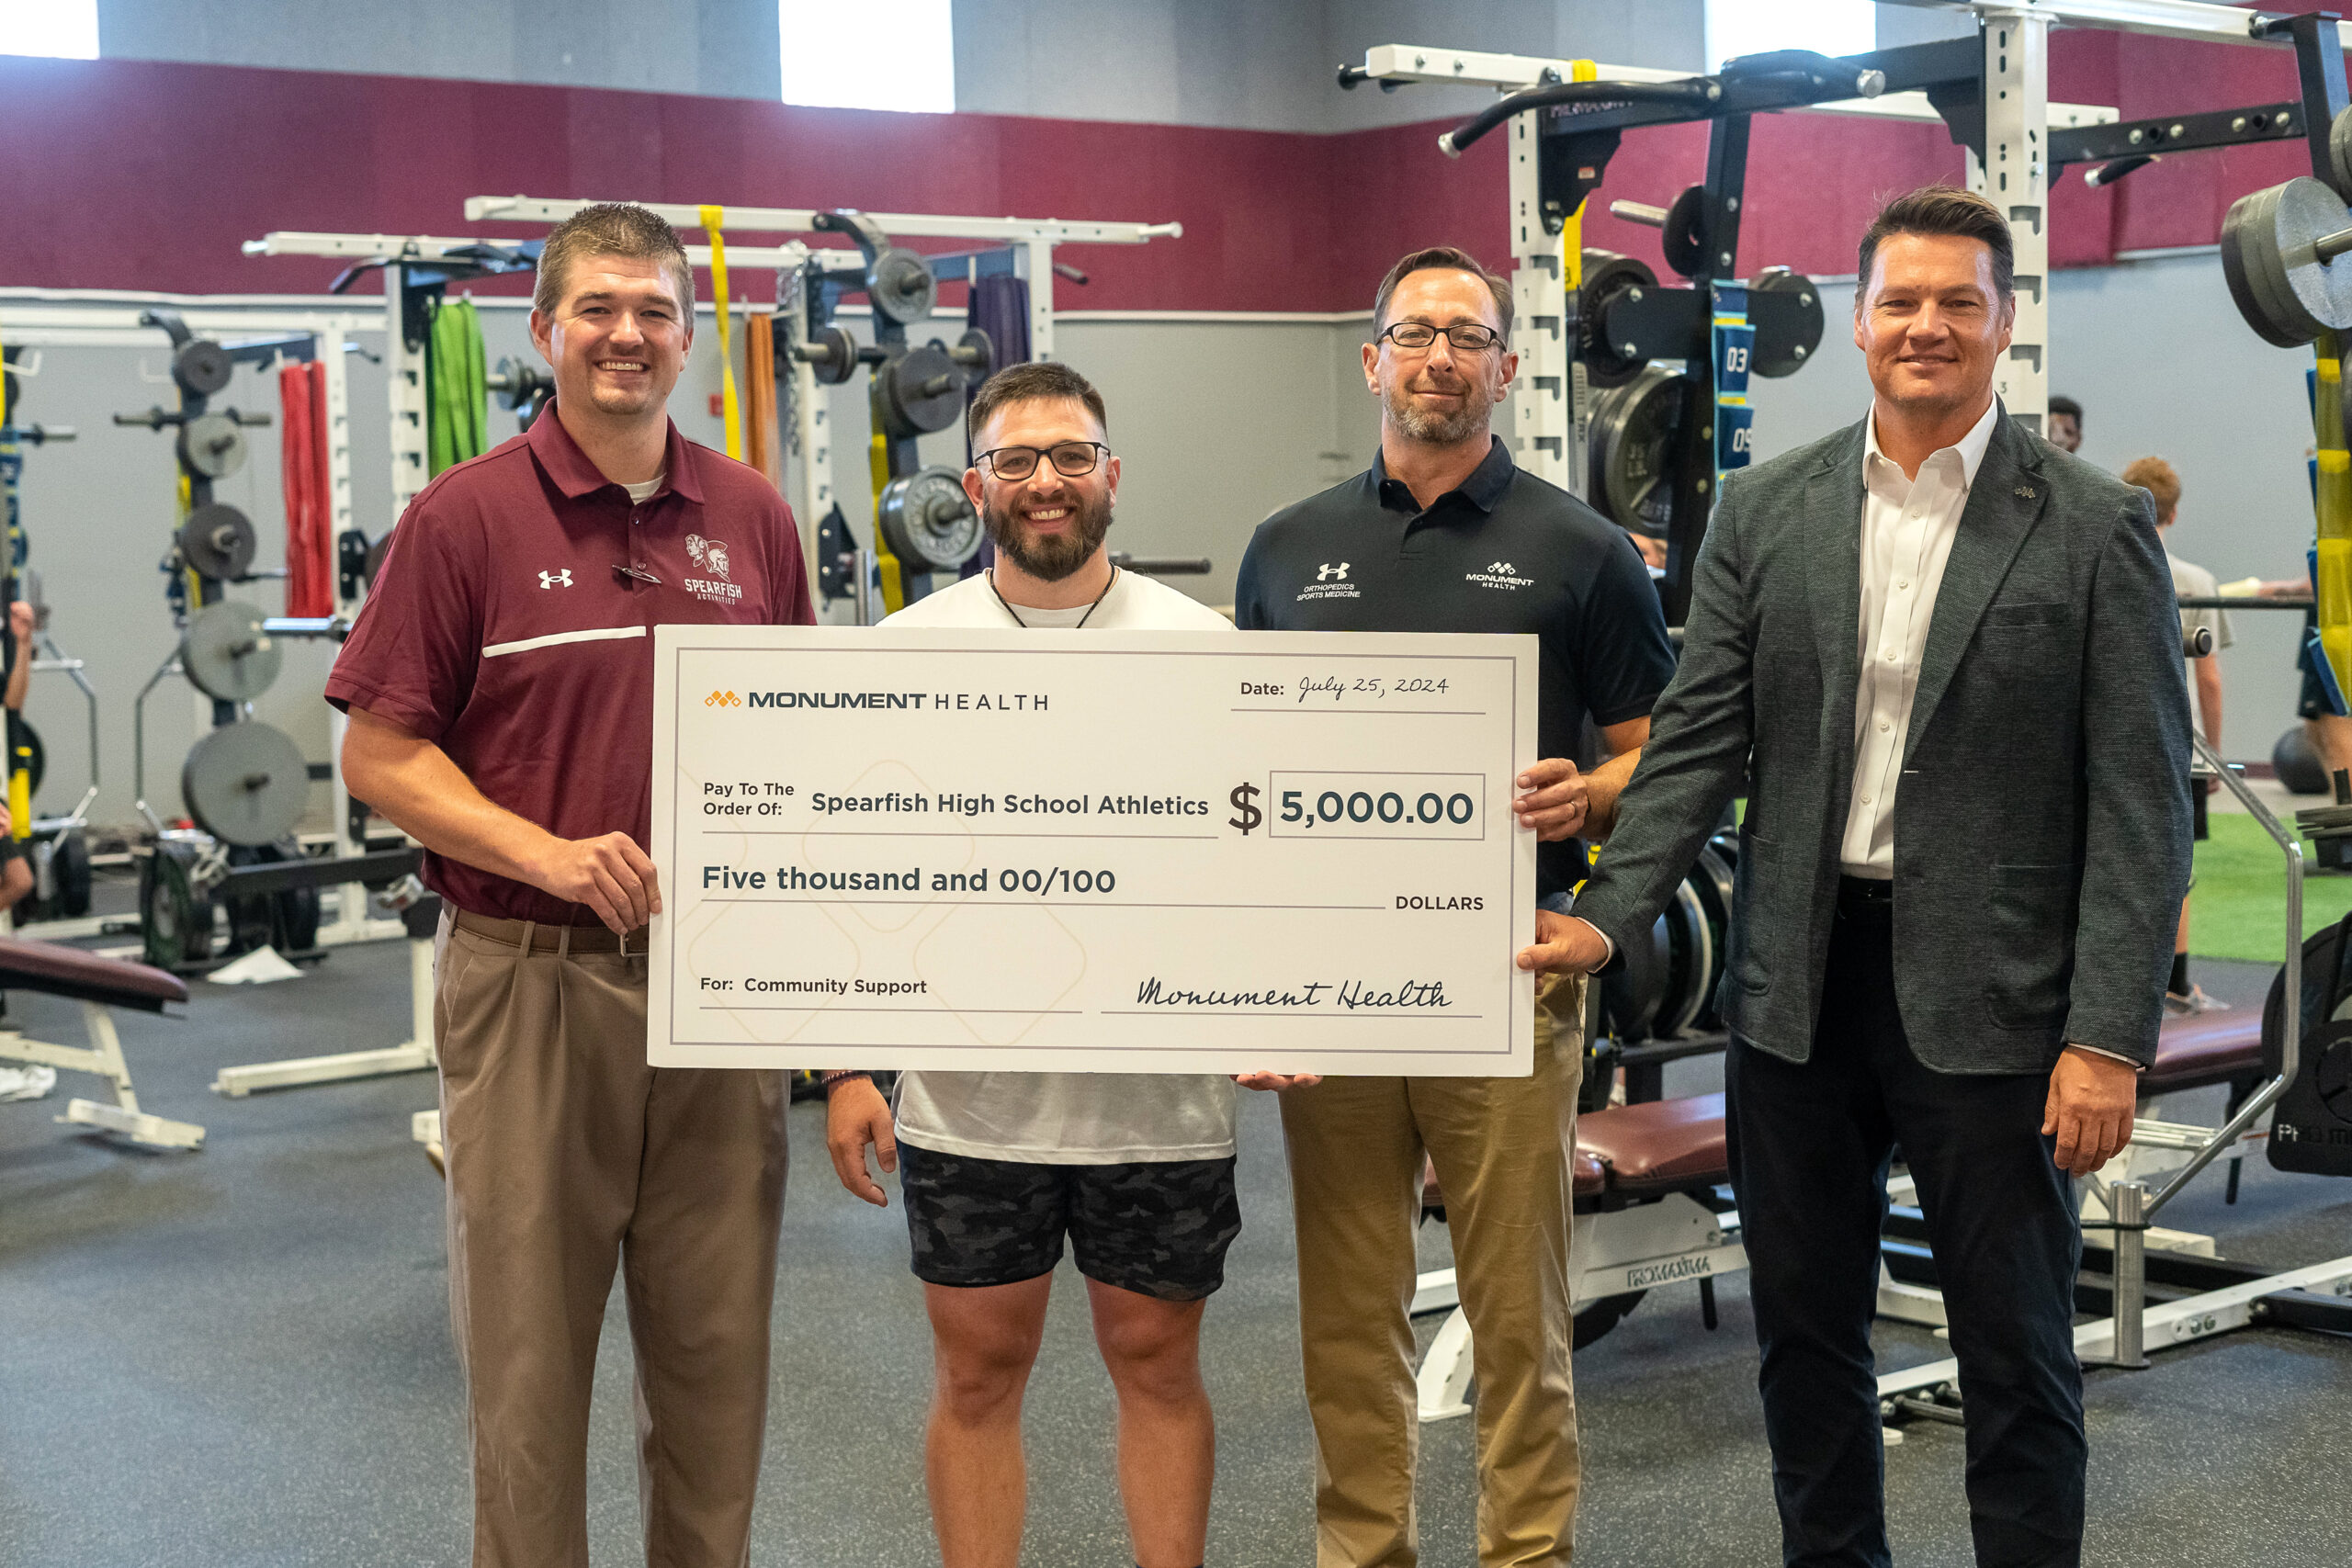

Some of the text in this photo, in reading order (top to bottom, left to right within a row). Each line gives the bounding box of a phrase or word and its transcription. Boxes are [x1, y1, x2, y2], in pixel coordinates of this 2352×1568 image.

[1726, 346, 1748, 373] 03
[1999, 381, 2007, 394] 3
[684, 578, 742, 599] SPEARFISH
[1304, 583, 1355, 593] ORTHOPEDICS
[1465, 573, 1534, 587] MONUMENT
[1482, 581, 1516, 591] HEALTH
[696, 592, 736, 605] ACTIVITIES
[1296, 590, 1361, 601] SPORTS MEDICINE
[1240, 675, 1450, 704] Date: July 25, 2024
[748, 692, 1049, 711] MONUMENT HEALTH
[704, 782, 795, 798] Pay To The
[703, 802, 783, 816] Order Of:
[811, 792, 1209, 817] Spearfish High School Athletics
[1227, 782, 1474, 836] $ 5,000.00
[702, 865, 1116, 897] Five thousand and 00/100
[1396, 896, 1484, 911] DOLLARS
[700, 976, 928, 997] For: Community Support
[1136, 976, 1453, 1010] Monument Health
